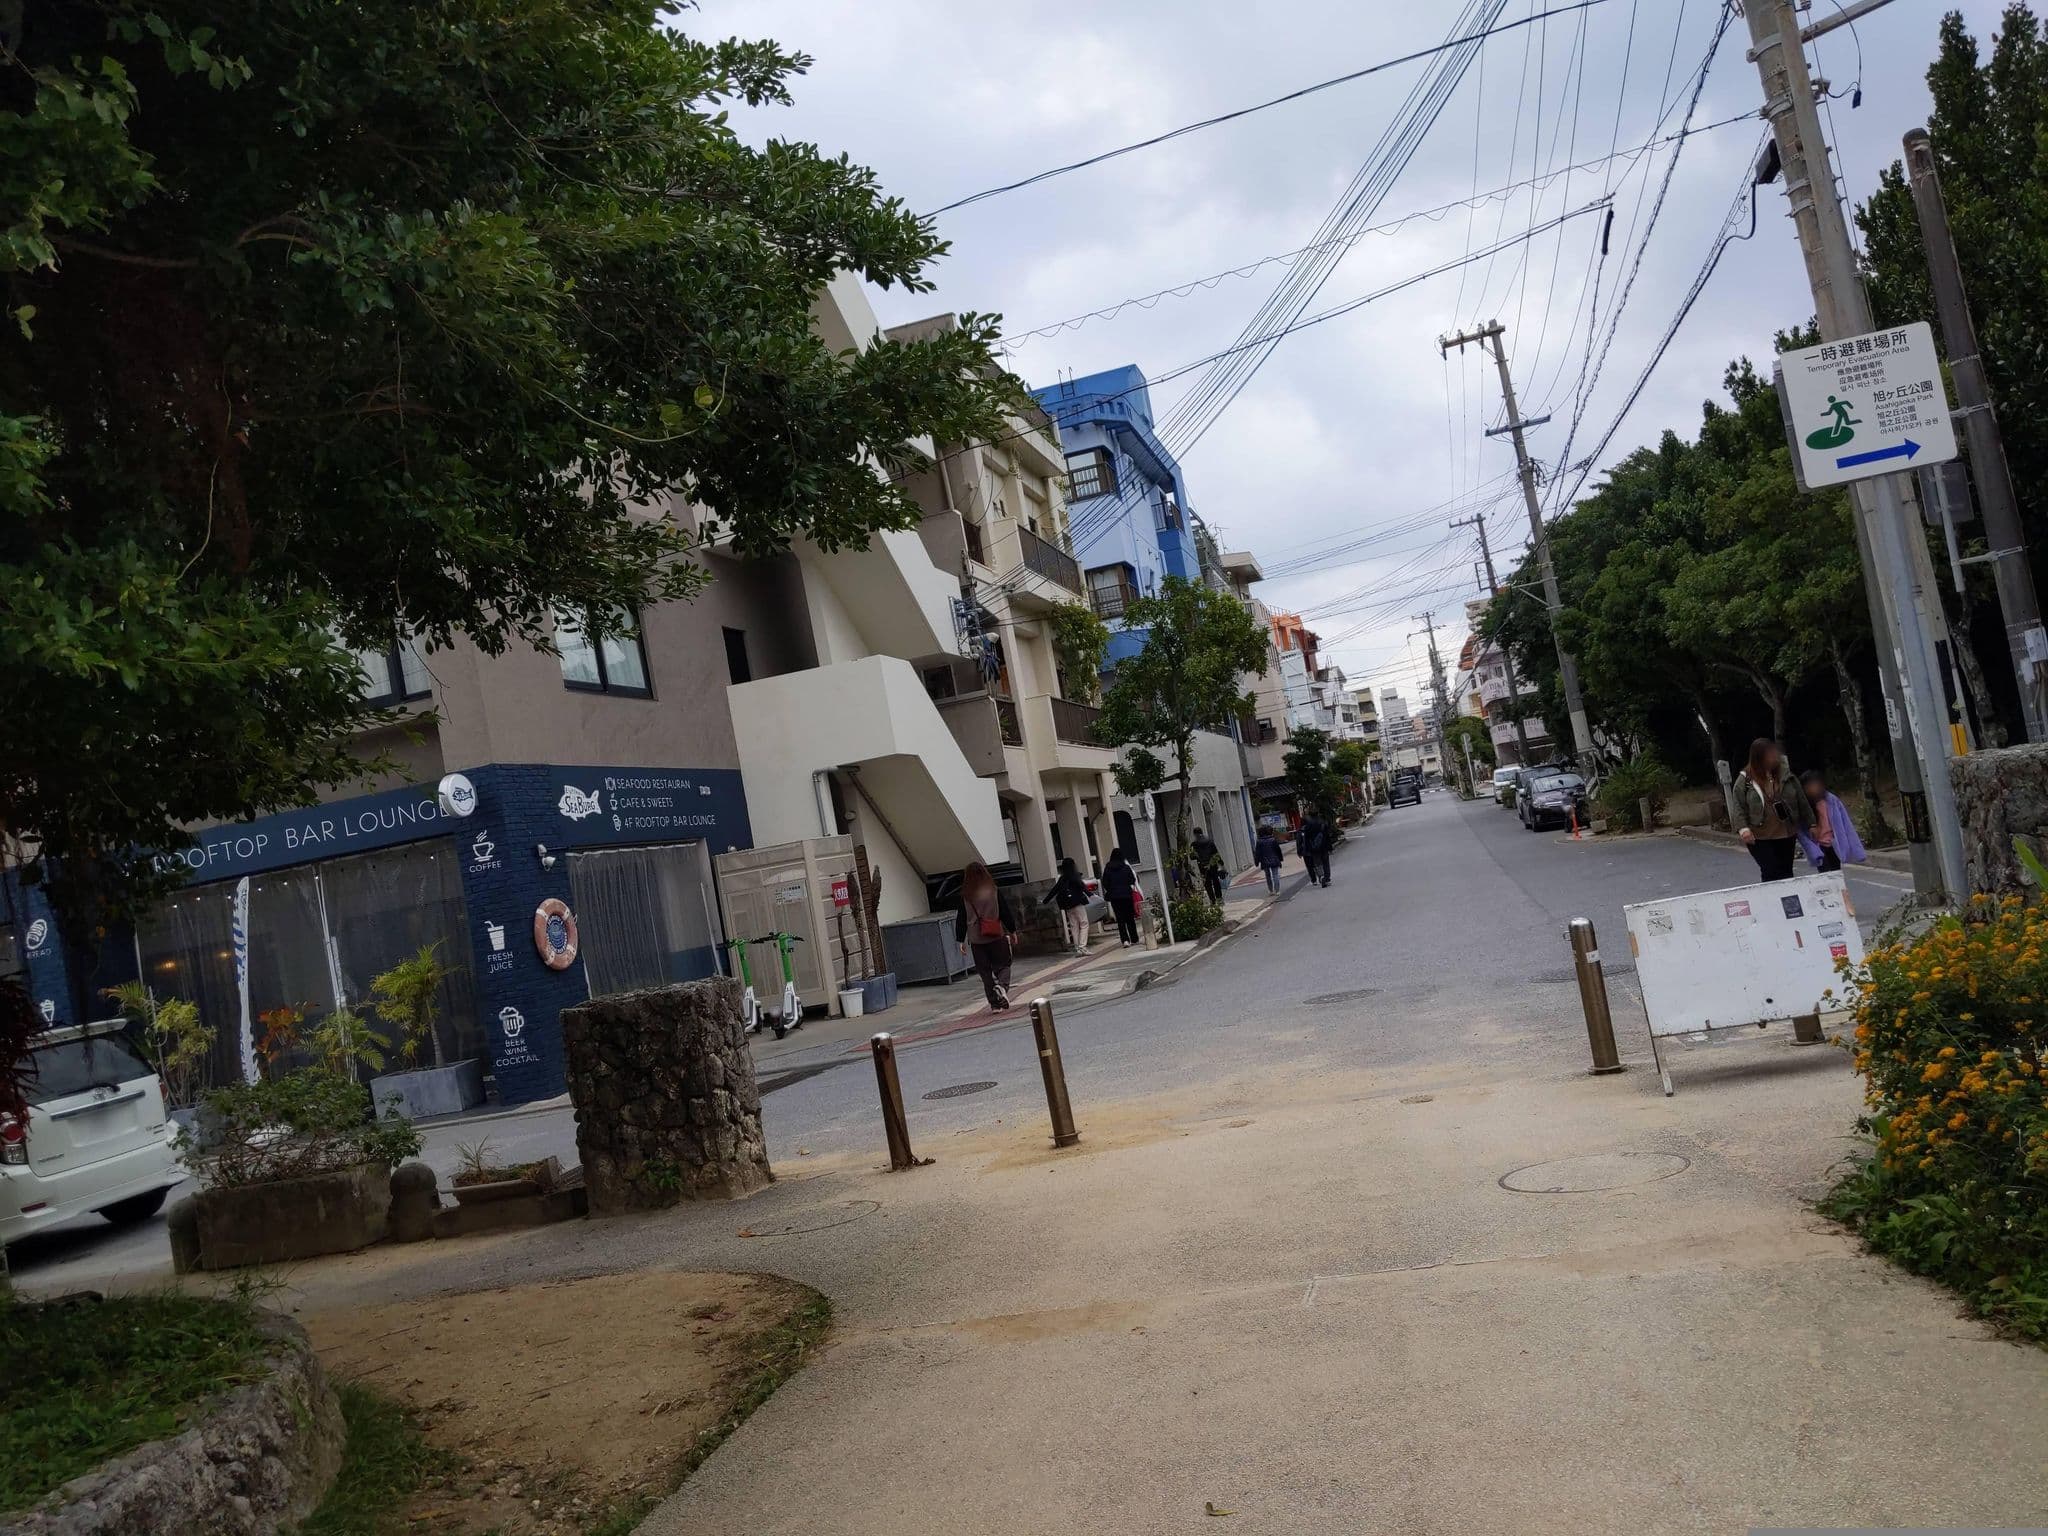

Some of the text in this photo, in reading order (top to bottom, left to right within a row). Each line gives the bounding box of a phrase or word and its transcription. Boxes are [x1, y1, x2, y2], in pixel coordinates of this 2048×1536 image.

[1804, 330, 1907, 361] 一時避難場所
[1807, 345, 1910, 373] Temporary Evacuation Area
[1873, 380, 1933, 403] 旭ヶ丘公園
[1875, 393, 1934, 410] Asahigaoka Park
[617, 777, 652, 790] SEAFOOD
[620, 797, 674, 809] CAFE & SWEETS
[624, 814, 716, 828] 4F ROOFTOP BAR LOUNGE
[285, 820, 336, 849] BAR
[469, 860, 502, 873] COFFEE
[487, 951, 514, 963] FRESH
[489, 961, 513, 974] JUICE
[505, 1038, 526, 1048] BEER
[504, 1046, 528, 1056] WINE
[496, 1054, 541, 1067] COCKTAIL
